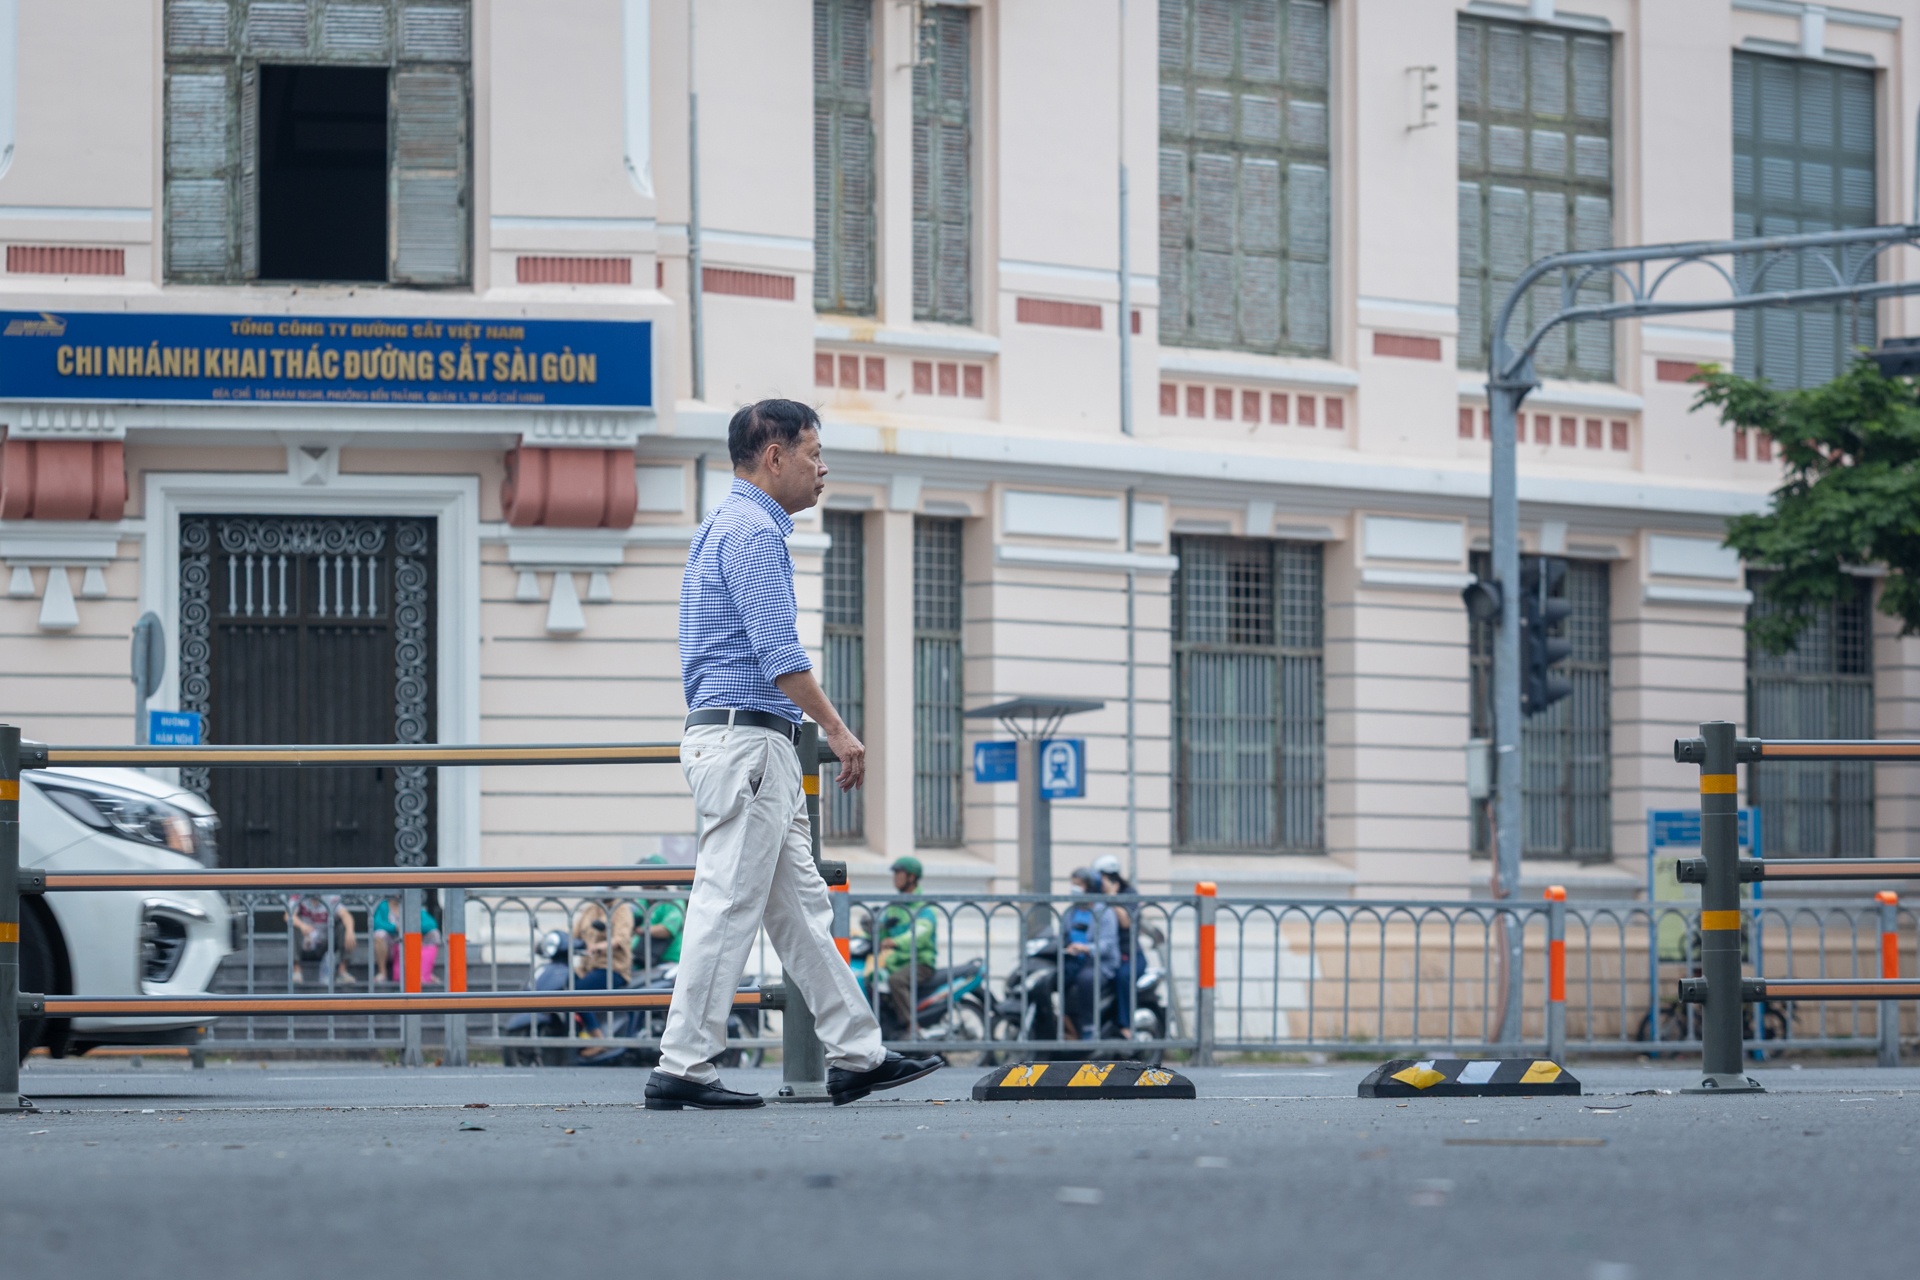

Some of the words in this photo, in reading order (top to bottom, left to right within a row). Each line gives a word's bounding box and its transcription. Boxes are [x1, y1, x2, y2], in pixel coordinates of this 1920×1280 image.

[230, 317, 274, 336] TỔNG
[278, 319, 324, 337] CÔNG
[329, 323, 347, 337] TY
[351, 320, 408, 338] ĐƯỜNG
[412, 321, 443, 339] SẮT
[447, 322, 482, 340] VIỆT
[486, 325, 524, 340] NAM
[56, 344, 102, 376] CHI
[107, 340, 200, 378] NHÁNH
[204, 347, 266, 379] KHAI
[270, 343, 340, 380] THÁC
[344, 343, 435, 381] ĐƯỜNG
[438, 343, 489, 382] SẮT
[493, 347, 537, 382] SÀI
[541, 346, 597, 384] GÒN
